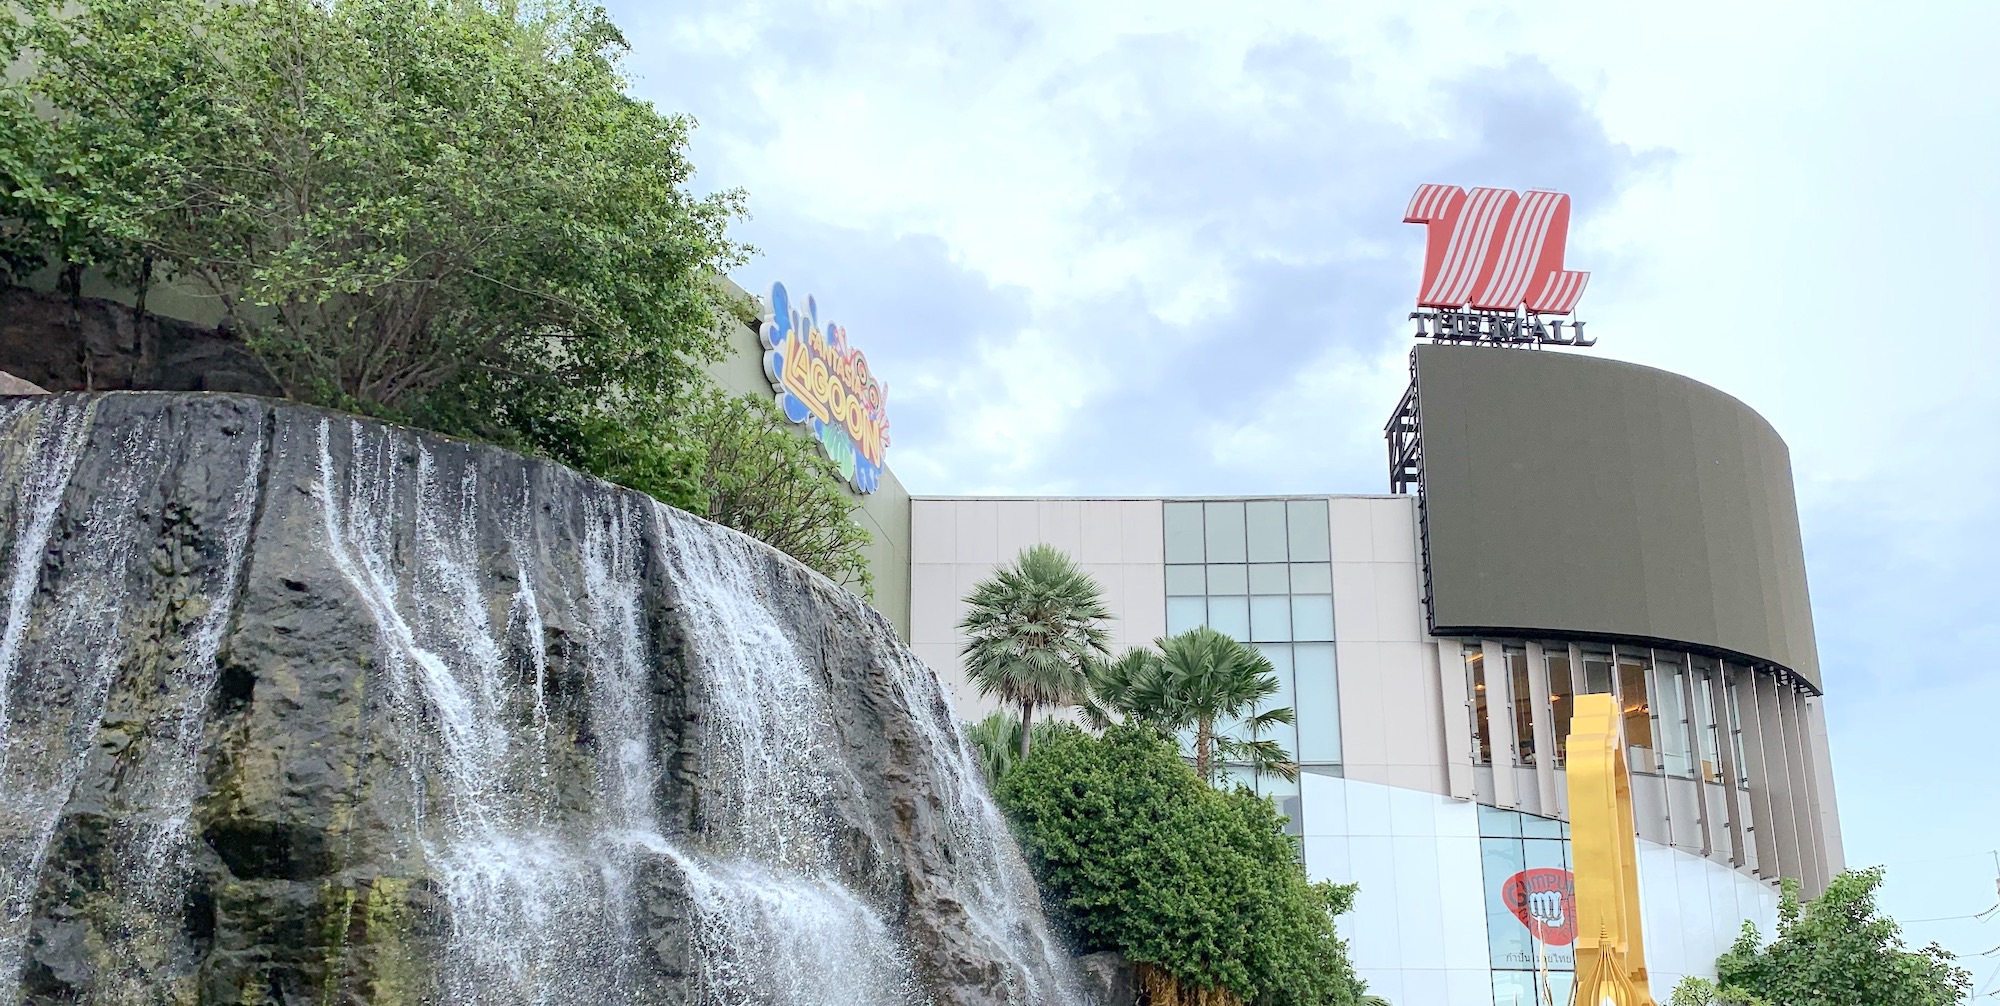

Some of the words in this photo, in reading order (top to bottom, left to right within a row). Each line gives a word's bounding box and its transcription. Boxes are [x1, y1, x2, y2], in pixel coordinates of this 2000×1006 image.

[1408, 312, 1482, 338] THE
[1488, 316, 1598, 347] MALL
[781, 329, 881, 468] LAGOON
